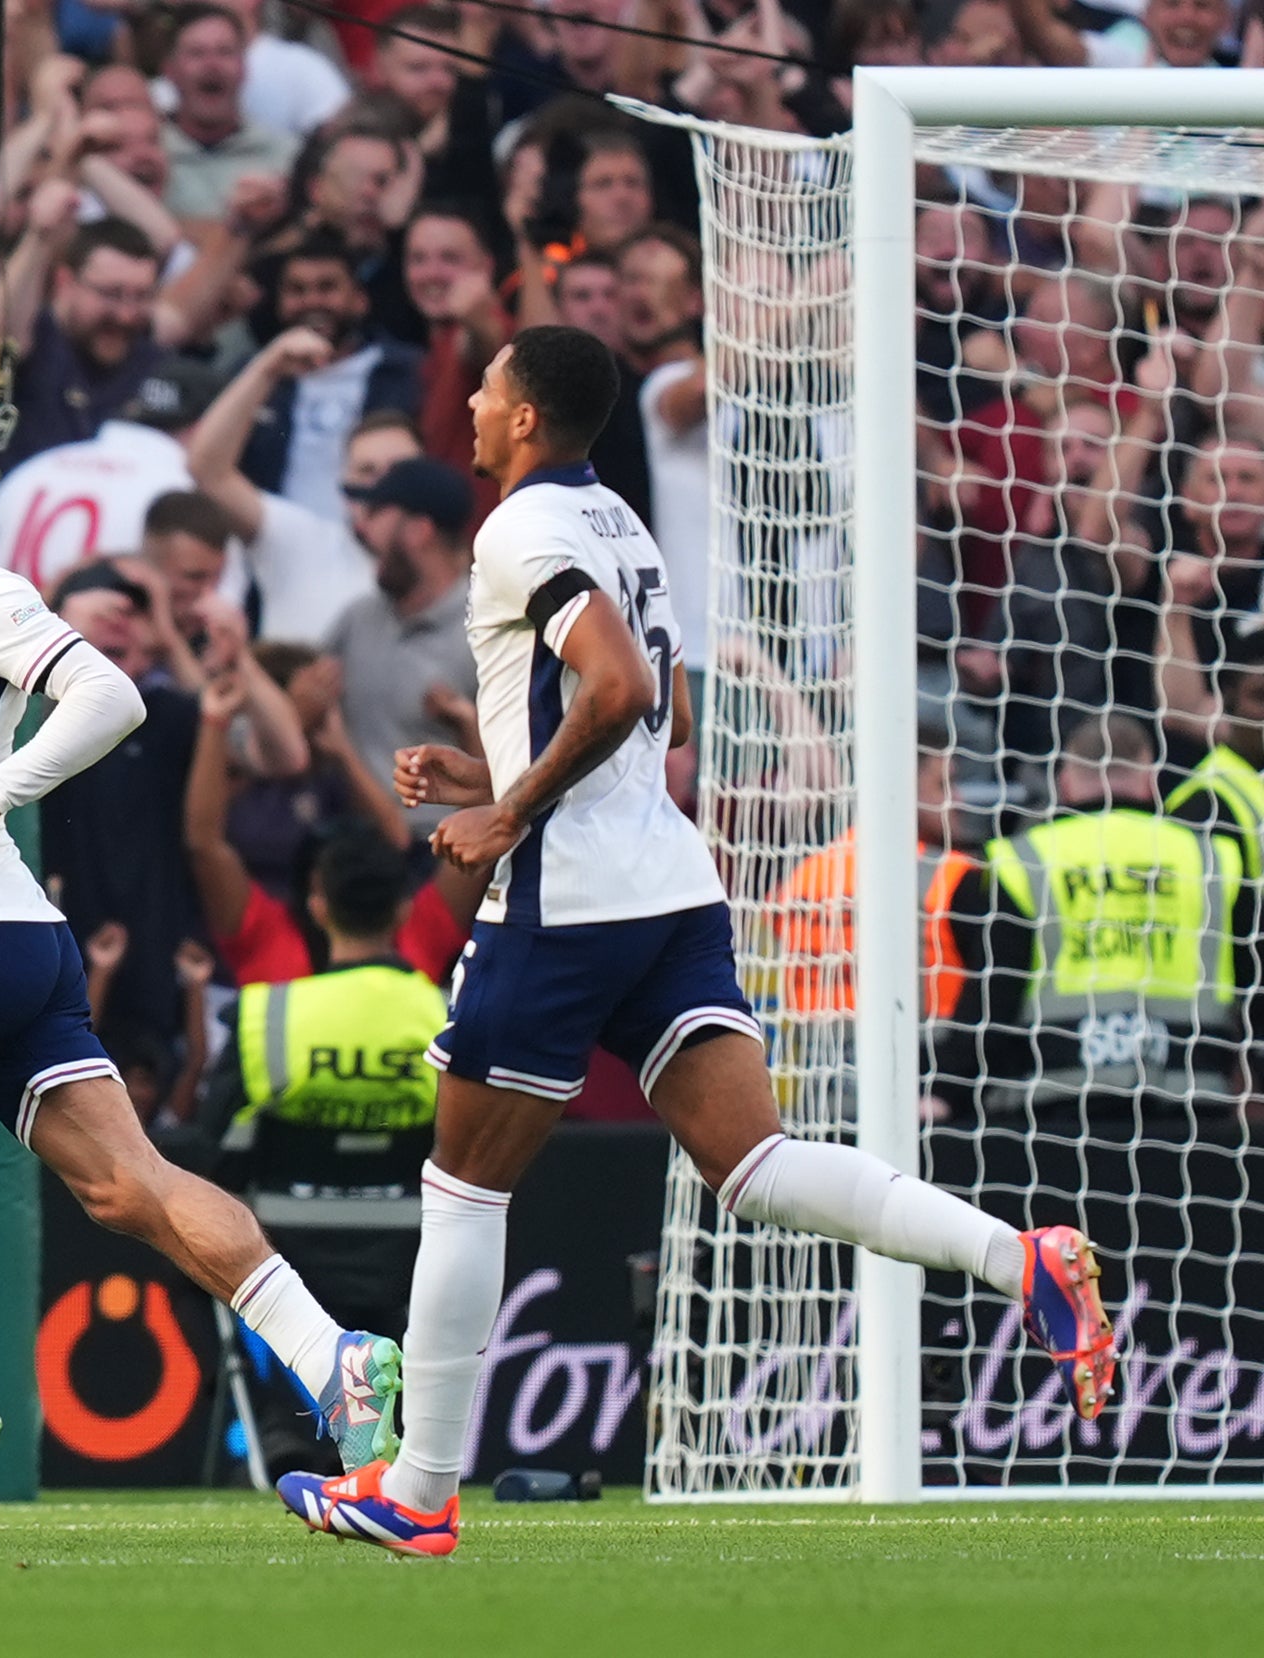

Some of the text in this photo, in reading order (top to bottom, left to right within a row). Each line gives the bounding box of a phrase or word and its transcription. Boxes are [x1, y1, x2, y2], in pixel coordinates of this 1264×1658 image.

[9, 487, 102, 589] 10
[1063, 864, 1178, 901] PULSE
[309, 1046, 427, 1082] PULSE
[460, 1267, 672, 1481] for
